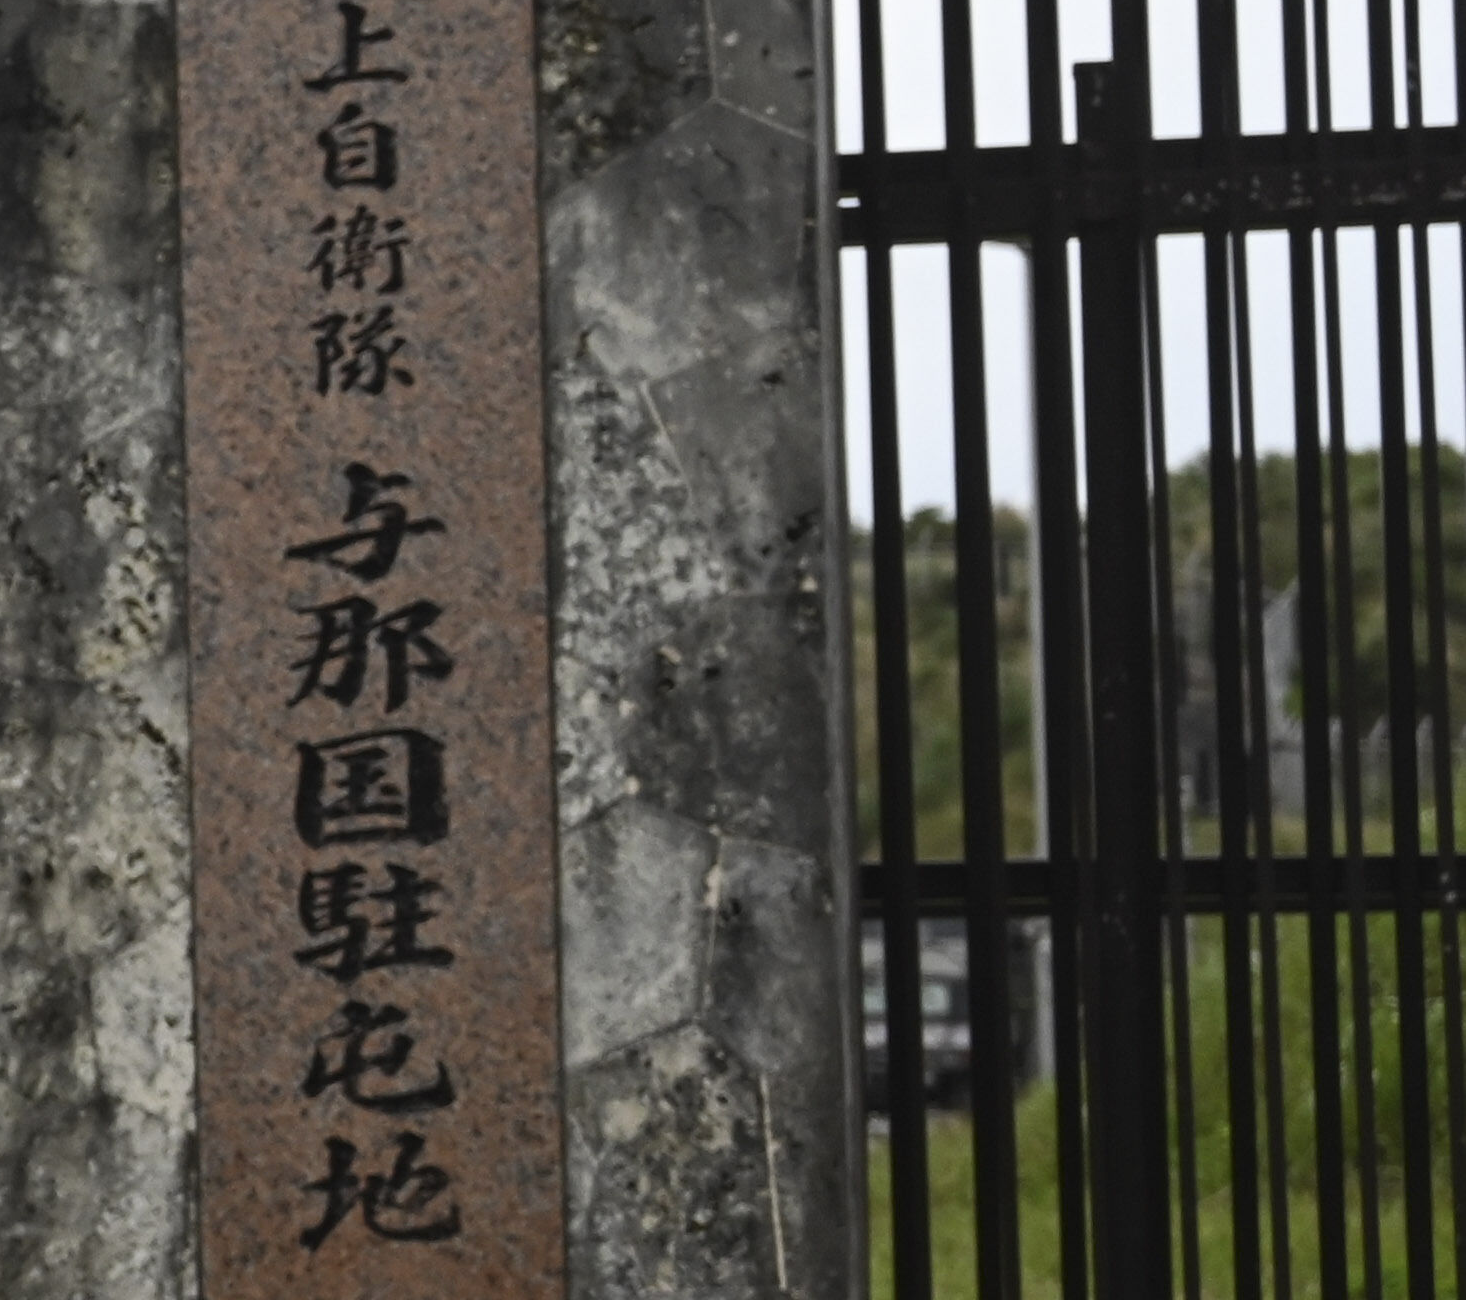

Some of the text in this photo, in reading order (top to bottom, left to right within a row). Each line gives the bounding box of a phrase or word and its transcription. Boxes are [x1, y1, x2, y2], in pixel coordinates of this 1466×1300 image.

[284, 462, 461, 1253] 与那国駐屯地
